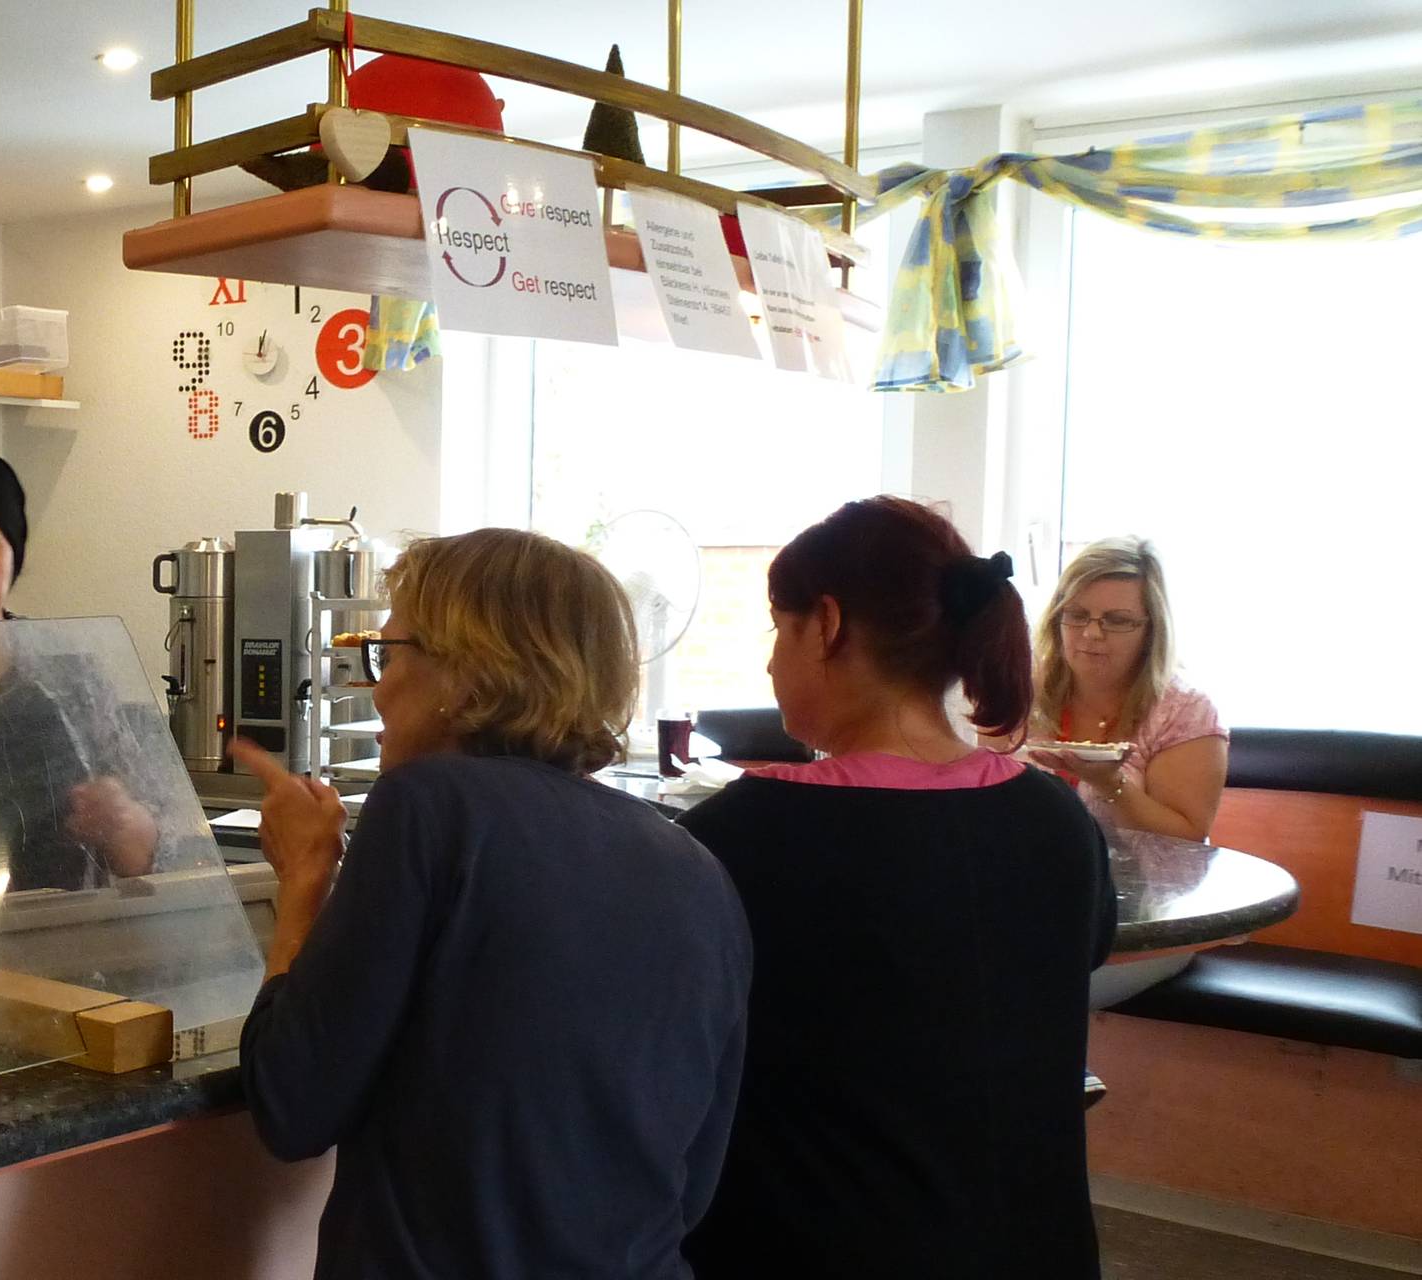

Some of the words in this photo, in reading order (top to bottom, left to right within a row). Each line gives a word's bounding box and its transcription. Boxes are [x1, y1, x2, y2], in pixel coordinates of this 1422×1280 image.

[500, 193, 535, 217] Gve
[540, 204, 593, 228] respect
[437, 222, 510, 255] Respect
[512, 271, 541, 294] Get
[544, 279, 598, 302] respect
[217, 321, 235, 337] 10
[310, 305, 321, 323] 2
[173, 331, 211, 392] 9
[336, 323, 365, 376] 3
[305, 376, 320, 400] 4
[188, 390, 219, 440] 8
[234, 402, 243, 416] 7
[290, 404, 301, 420] 5
[258, 416, 278, 448] 6
